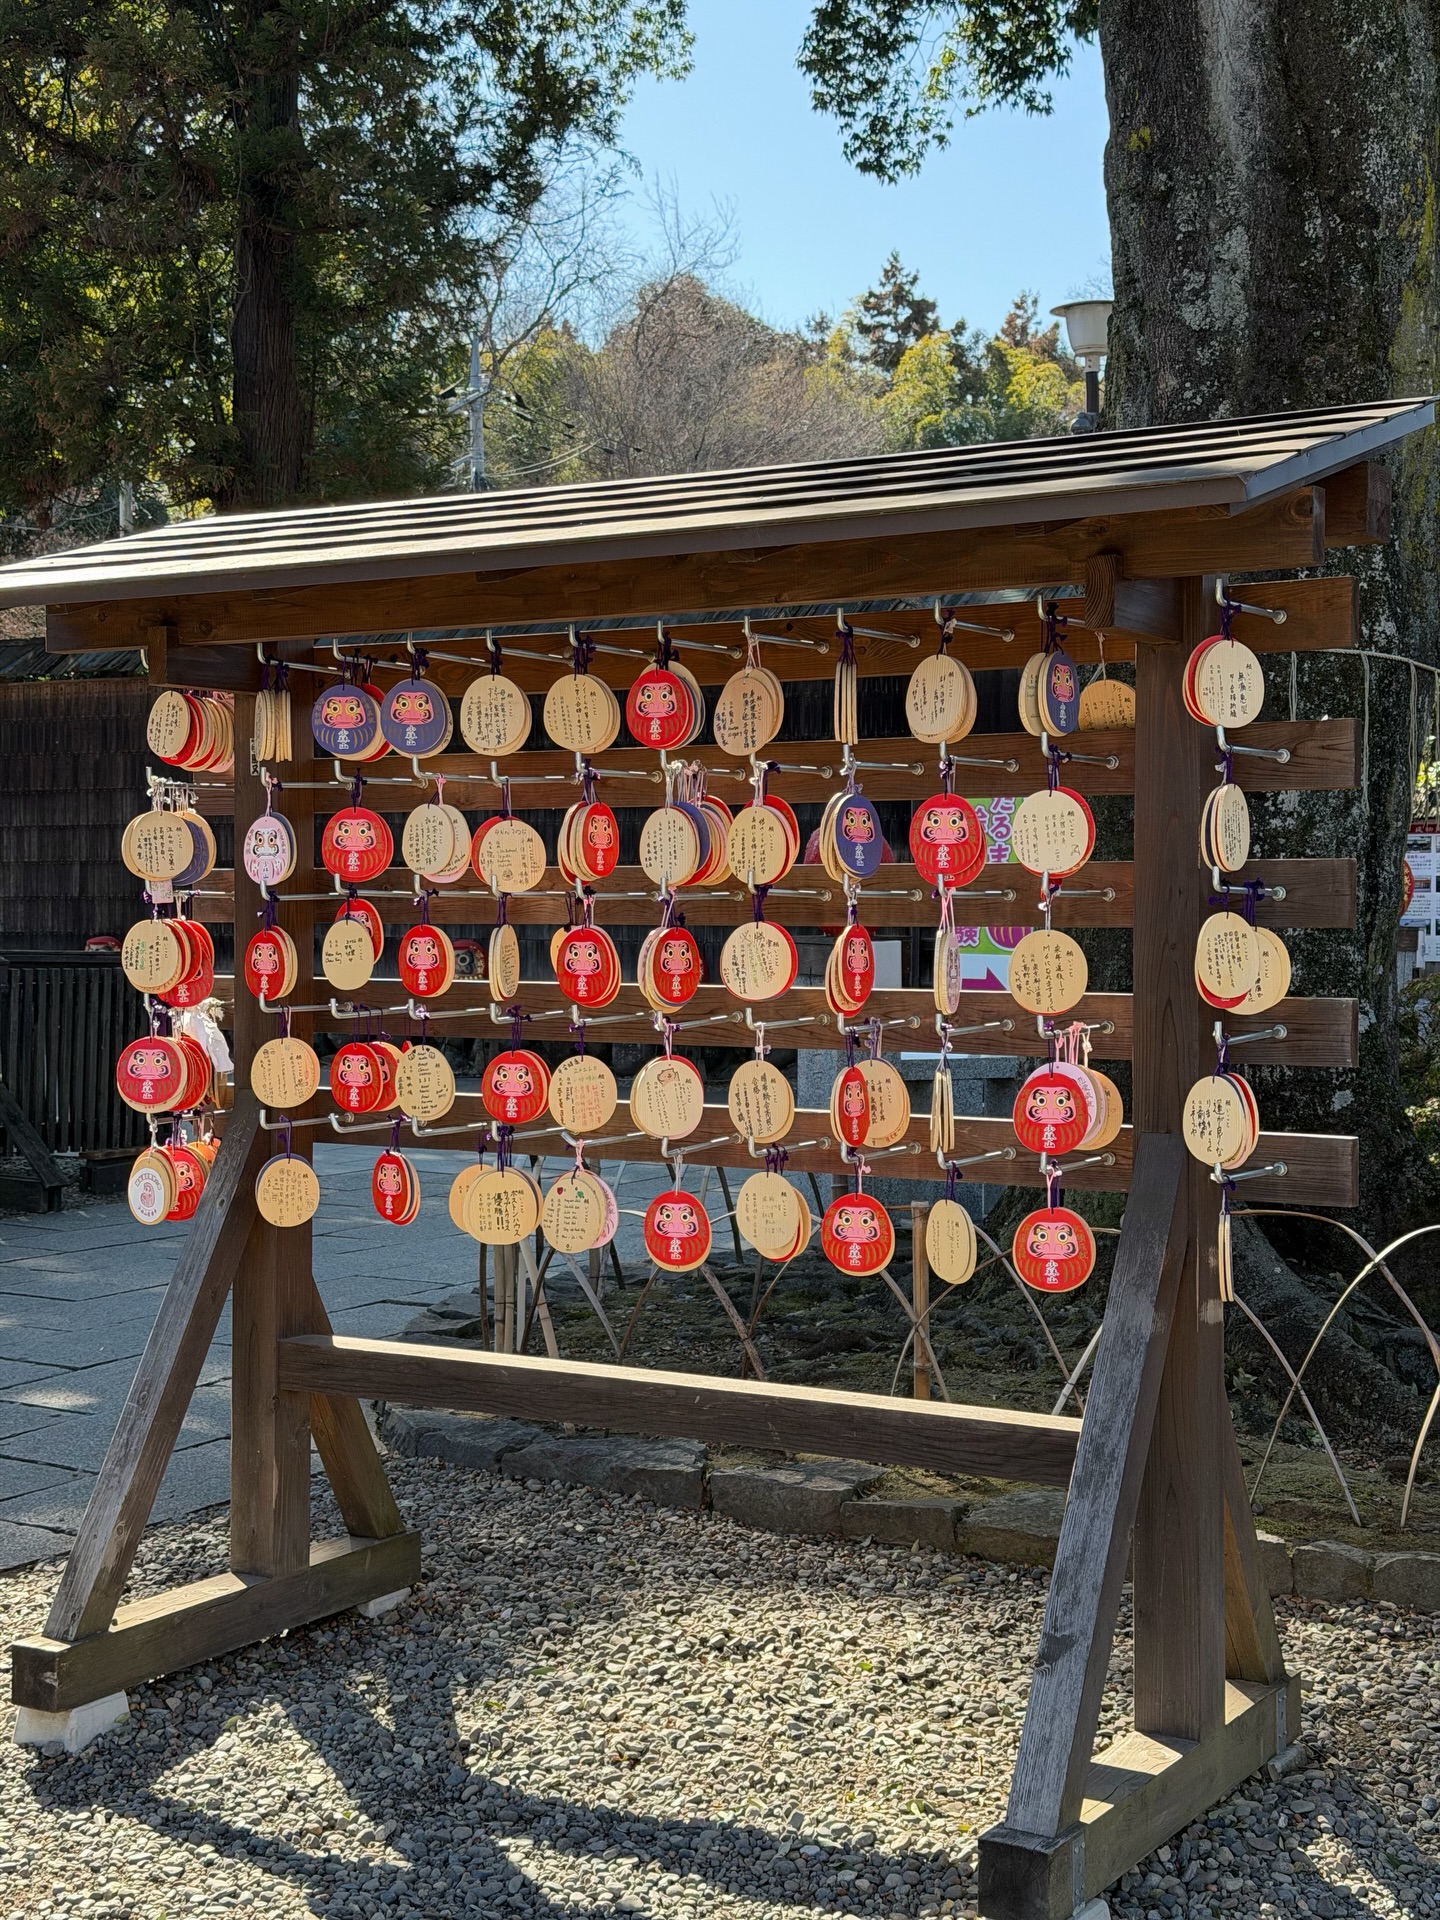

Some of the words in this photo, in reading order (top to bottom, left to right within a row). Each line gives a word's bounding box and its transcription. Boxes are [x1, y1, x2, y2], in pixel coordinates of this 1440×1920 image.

[337, 729, 350, 750] 少林山
[405, 725, 418, 746] 少林山
[649, 718, 662, 741] 少林山
[347, 850, 360, 871] 少林山
[936, 844, 951, 868] 少林山
[177, 984, 190, 1003] 少林山
[140, 1079, 154, 1099] 少林山
[348, 1086, 360, 1107] 少林山
[505, 1096, 518, 1118] 少林山
[1042, 1124, 1057, 1149] 少林山
[669, 1237, 683, 1260] 少林山
[848, 1243, 862, 1266] 少林山
[1044, 1260, 1059, 1284] 少林山
